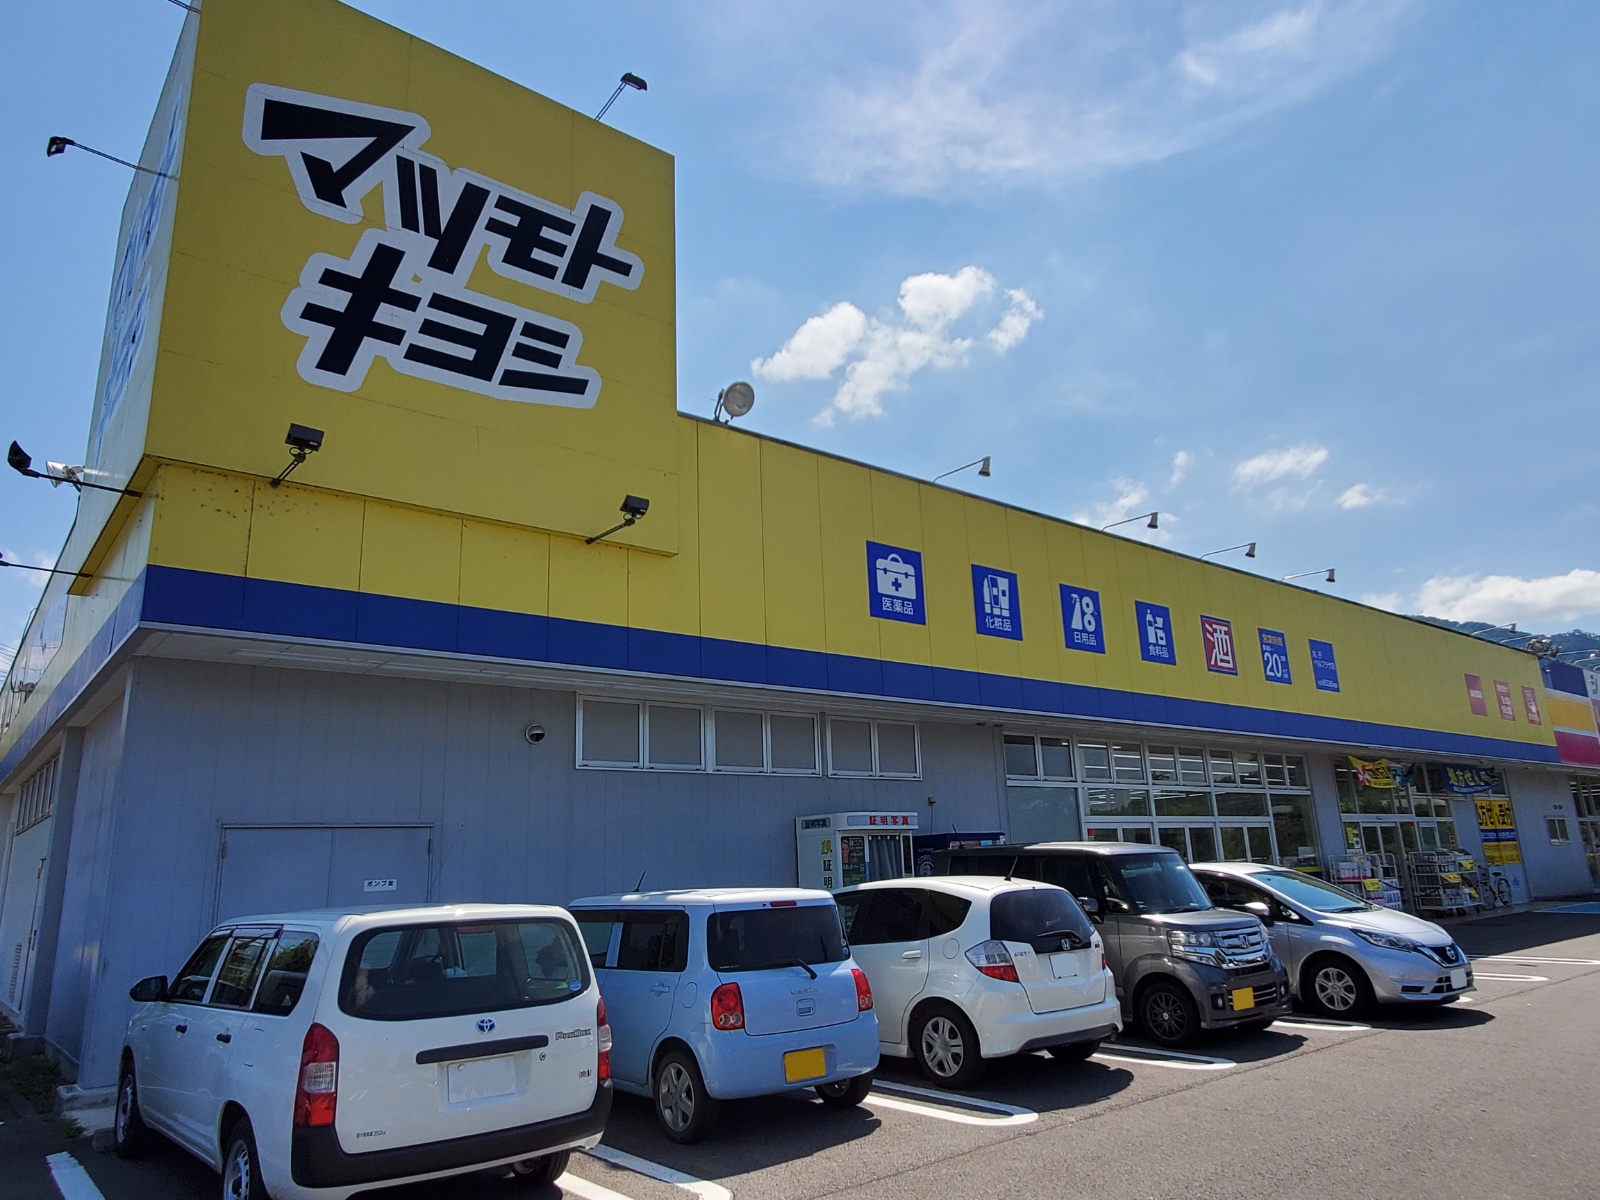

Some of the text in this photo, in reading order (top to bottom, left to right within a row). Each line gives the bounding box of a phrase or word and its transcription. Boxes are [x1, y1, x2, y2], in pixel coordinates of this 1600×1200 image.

[261, 98, 633, 290] マツモト
[299, 243, 590, 395] キヨシ
[882, 597, 914, 615] 医薬品
[985, 616, 1012, 631] 化粧品
[1074, 631, 1097, 646] 日用品
[1205, 622, 1234, 668] 酒
[1149, 644, 1169, 658] 食料品
[1264, 651, 1282, 678] 20
[869, 815, 909, 826] 証明写真
[823, 860, 833, 889] 証明
